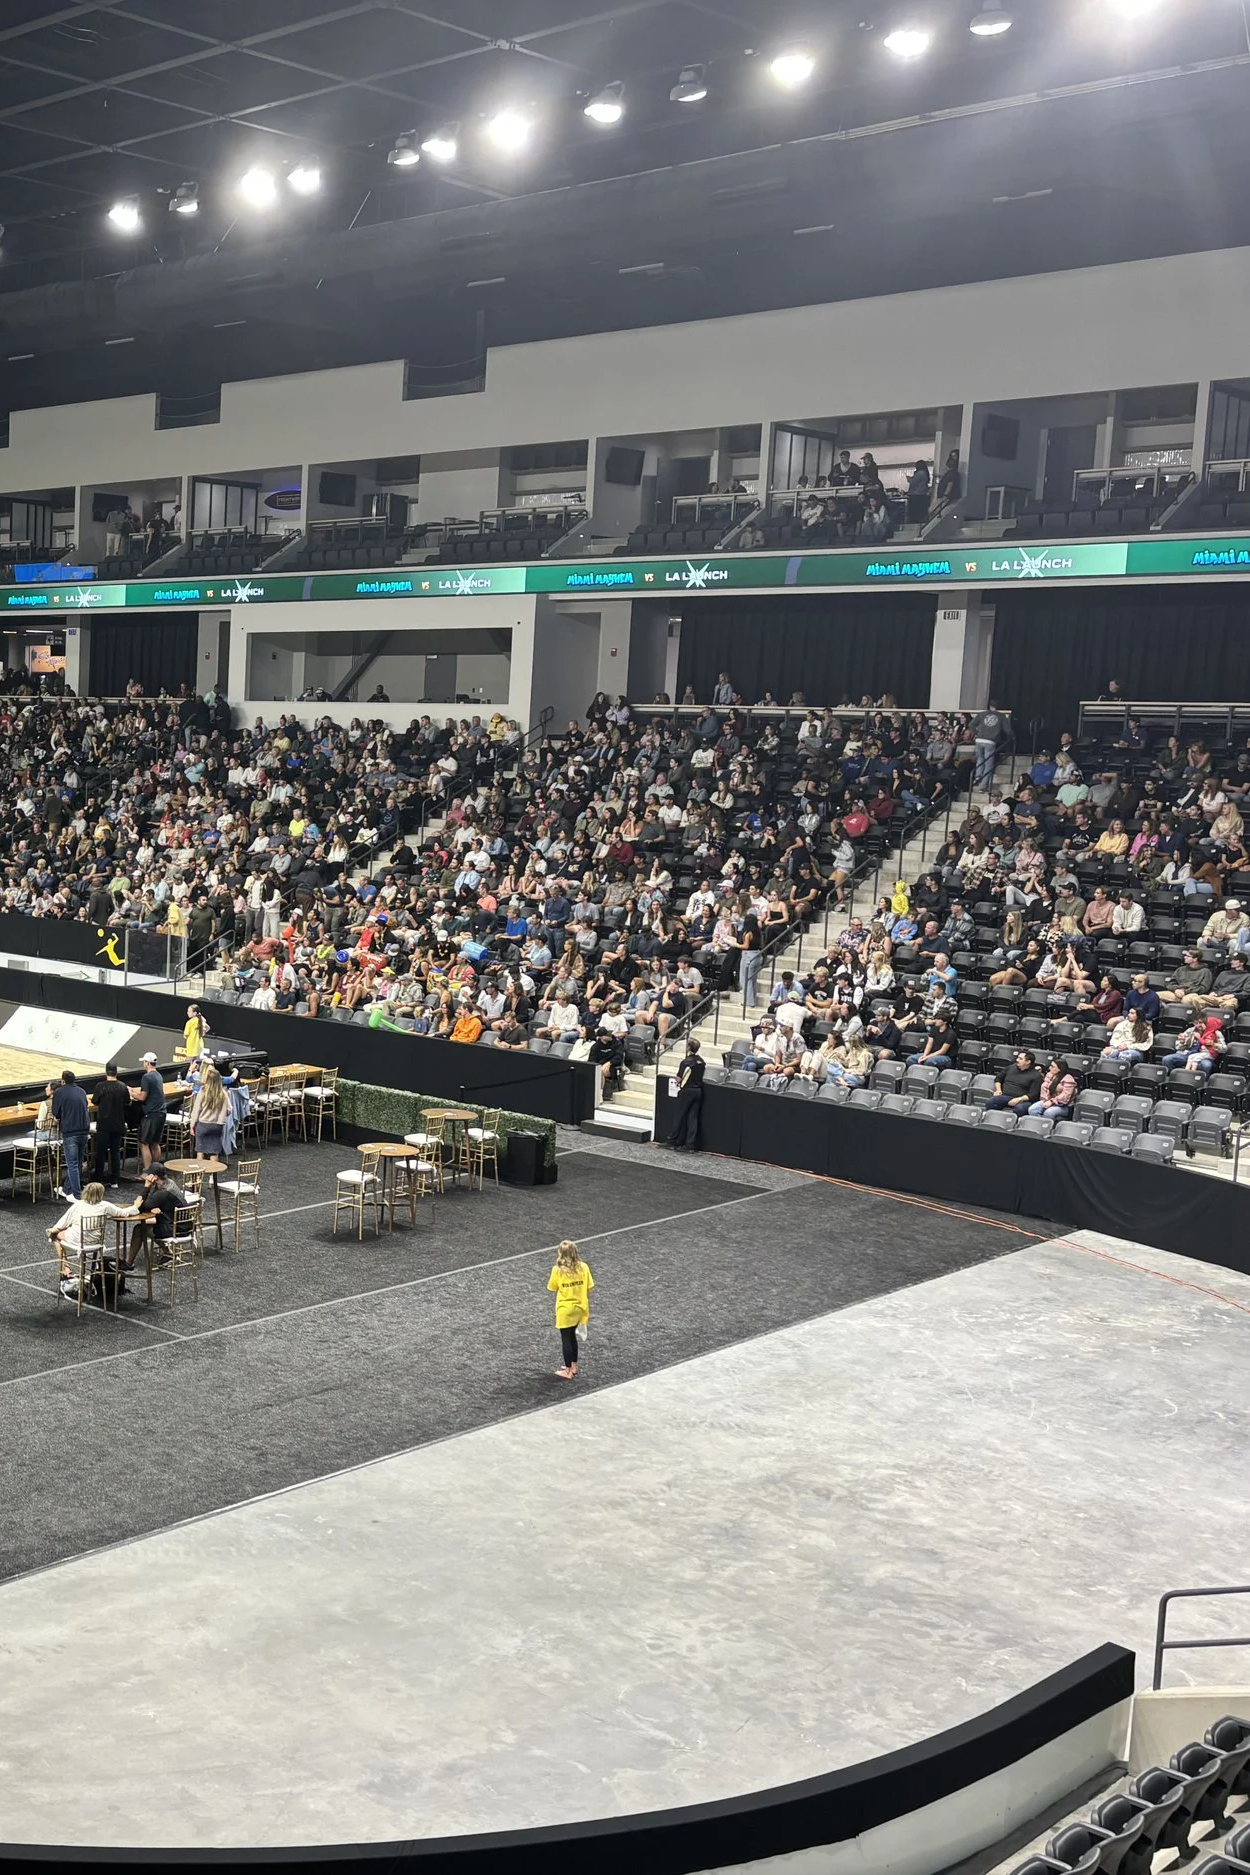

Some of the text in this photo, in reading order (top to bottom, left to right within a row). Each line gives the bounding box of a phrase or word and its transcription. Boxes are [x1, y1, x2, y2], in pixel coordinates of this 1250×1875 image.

[965, 562, 977, 572] VS
[992, 561, 1010, 570] LA
[645, 574, 654, 582] VS
[665, 572, 680, 581] LA
[422, 582, 430, 590] VS
